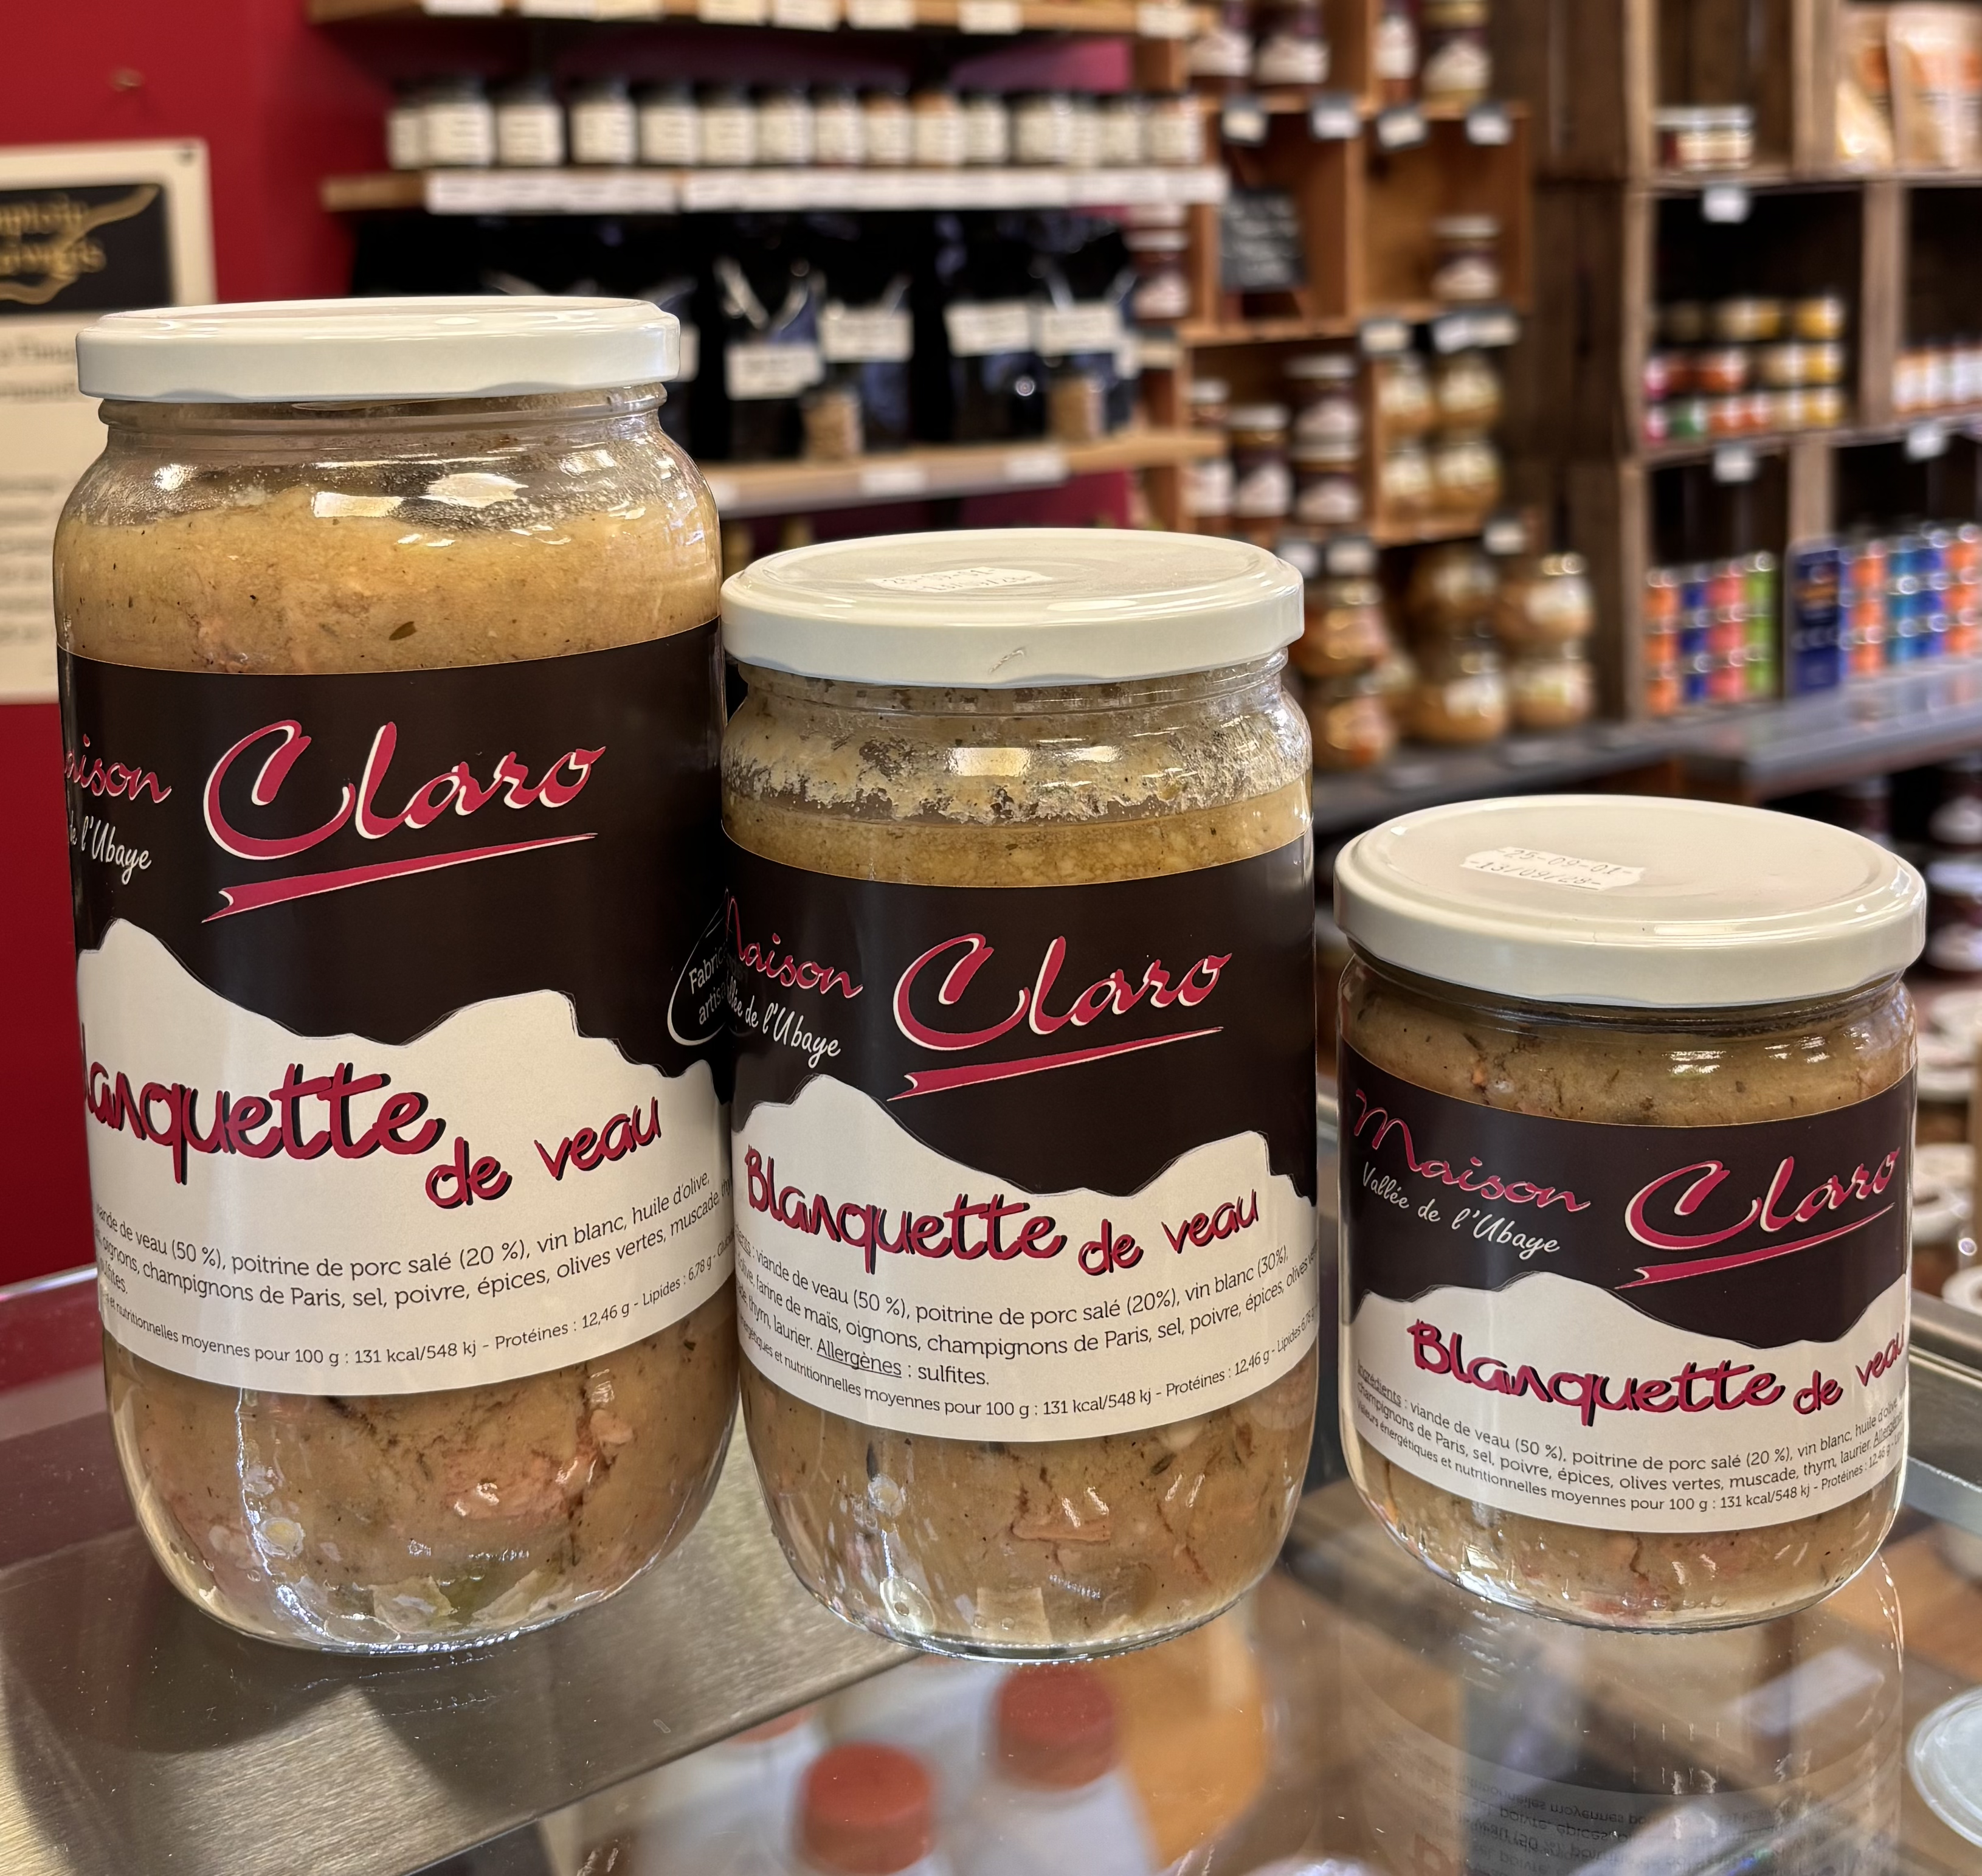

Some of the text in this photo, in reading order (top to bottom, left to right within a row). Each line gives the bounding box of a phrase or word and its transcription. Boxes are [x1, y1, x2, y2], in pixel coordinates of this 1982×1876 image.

[64, 719, 606, 860] aison Claro
[81, 815, 151, 885] l'Ubaye
[745, 995, 759, 1028] de
[762, 1002, 841, 1068] l'Ubaye
[893, 933, 1232, 1051] Claro
[88, 1062, 663, 1210] anquette de veau
[1354, 1089, 1901, 1250] Maison Claro
[120, 1220, 133, 1241] de
[136, 1231, 168, 1256] veau
[172, 1239, 196, 1262] (50
[202, 1247, 226, 1270] %),
[231, 1255, 309, 1276] poitrine
[316, 1258, 344, 1277] de
[350, 1260, 402, 1281] porc
[408, 1251, 452, 1274] salé
[460, 1245, 494, 1270] (20
[502, 1239, 530, 1261] %),
[537, 1233, 568, 1253] vin
[573, 1216, 627, 1244] blanc,
[632, 1196, 669, 1225] huile
[673, 1172, 710, 1205] d'olive,
[745, 1144, 1068, 1275] Blanquette
[1077, 1218, 1144, 1276] de
[1161, 1188, 1259, 1254] veau
[1362, 1161, 1561, 1260] Vallée de l'Ubaye
[103, 1236, 140, 1275] oignons,
[143, 1261, 254, 1302] champignons
[260, 1285, 285, 1304] de
[291, 1287, 345, 1309] Paris,
[353, 1288, 387, 1309] sel,
[395, 1284, 470, 1309] poivre,
[477, 1269, 550, 1298] épices,
[557, 1250, 611, 1278] olives
[615, 1228, 666, 1260] vertes,
[116, 1301, 179, 1343] nutritionnelles
[182, 1333, 250, 1359] moyennes
[255, 1347, 290, 1362] pour
[295, 1349, 324, 1363] 100
[329, 1353, 339, 1367] g
[354, 1349, 382, 1363] 131
[386, 1342, 458, 1363] kcal/548
[463, 1340, 476, 1357] kj
[495, 1323, 568, 1349] Protéines
[582, 1304, 618, 1329] 12,46
[621, 1303, 630, 1318] g
[642, 1277, 681, 1306] Lipides
[688, 1258, 705, 1281] 6,78
[706, 1256, 712, 1270] g
[756, 1248, 789, 1281] viande
[792, 1270, 809, 1290] de
[812, 1280, 848, 1304] veau
[854, 1289, 880, 1312] (50
[886, 1296, 910, 1320] %),
[916, 1305, 993, 1325] poitrine
[999, 1307, 1025, 1325] de
[1030, 1309, 1077, 1329] porc
[1083, 1299, 1120, 1321] salé
[1127, 1287, 1179, 1316] (20%),
[1184, 1281, 1210, 1302] vin
[1215, 1267, 1255, 1294] blanc
[1258, 1244, 1288, 1278] (30%),
[756, 1274, 782, 1307] farine
[786, 1295, 801, 1316] de
[804, 1307, 841, 1334] maïs,
[846, 1320, 921, 1351] oignons,
[927, 1334, 1068, 1360] champignons
[1073, 1334, 1099, 1352] de
[1104, 1326, 1152, 1349] Paris,
[1157, 1317, 1185, 1339] sel,
[1190, 1303, 1241, 1335] poivre,
[1245, 1281, 1285, 1312] épices,
[773, 1314, 813, 1351] laurier.
[817, 1338, 902, 1377] Allergènes
[917, 1365, 990, 1386] sulfites.
[775, 1350, 783, 1365] et
[784, 1355, 862, 1397] nutritionnelles
[865, 1388, 941, 1411] moyennes
[944, 1401, 982, 1416] pour
[986, 1401, 1014, 1416] 100
[1019, 1405, 1030, 1419] g
[1043, 1400, 1068, 1416] 131
[1072, 1392, 1136, 1413] kcal/548
[1139, 1387, 1152, 1405] kj
[1166, 1368, 1225, 1397] Protéines
[1234, 1351, 1261, 1377] 12,46
[1263, 1349, 1270, 1365] g
[1406, 1318, 1905, 1427] Blanquette de veau
[1357, 1382, 1414, 1432] champignons
[1417, 1424, 1432, 1440] de
[1435, 1431, 1469, 1458] Paris,
[1473, 1449, 1495, 1466] sel,
[1500, 1456, 1552, 1480] poivre,
[1557, 1467, 1614, 1488] épices,
[1620, 1476, 1667, 1490] olives
[1672, 1475, 1724, 1491] vertes,
[1730, 1467, 1799, 1489] muscade,
[1803, 1459, 1837, 1476] thym,
[1840, 1439, 1871, 1464] laurier.
[1379, 1421, 1438, 1463] énergétiques
[1441, 1456, 1452, 1469] et
[1454, 1462, 1547, 1497] nutritionnelles
[1551, 1488, 1626, 1508] moyennes
[1630, 1499, 1665, 1511] pour
[1668, 1498, 1694, 1509] 100
[1698, 1500, 1708, 1512] g
[1720, 1496, 1742, 1509] 131
[1745, 1486, 1798, 1507] kcal/548
[1800, 1483, 1810, 1498] kj
[1821, 1466, 1863, 1490] Protéines
[1410, 1402, 1450, 1429] viande
[1454, 1421, 1471, 1436] de
[1474, 1428, 1510, 1449] veau
[1514, 1438, 1539, 1455] (50
[1572, 1451, 1638, 1469] poitrine
[1642, 1456, 1663, 1470] de
[1668, 1458, 1706, 1473] porc
[1711, 1454, 1741, 1469] salé
[1746, 1450, 1769, 1468] (20
[1797, 1442, 1817, 1457] vin
[1820, 1430, 1853, 1452] blanc,
[1855, 1416, 1877, 1437] huile
